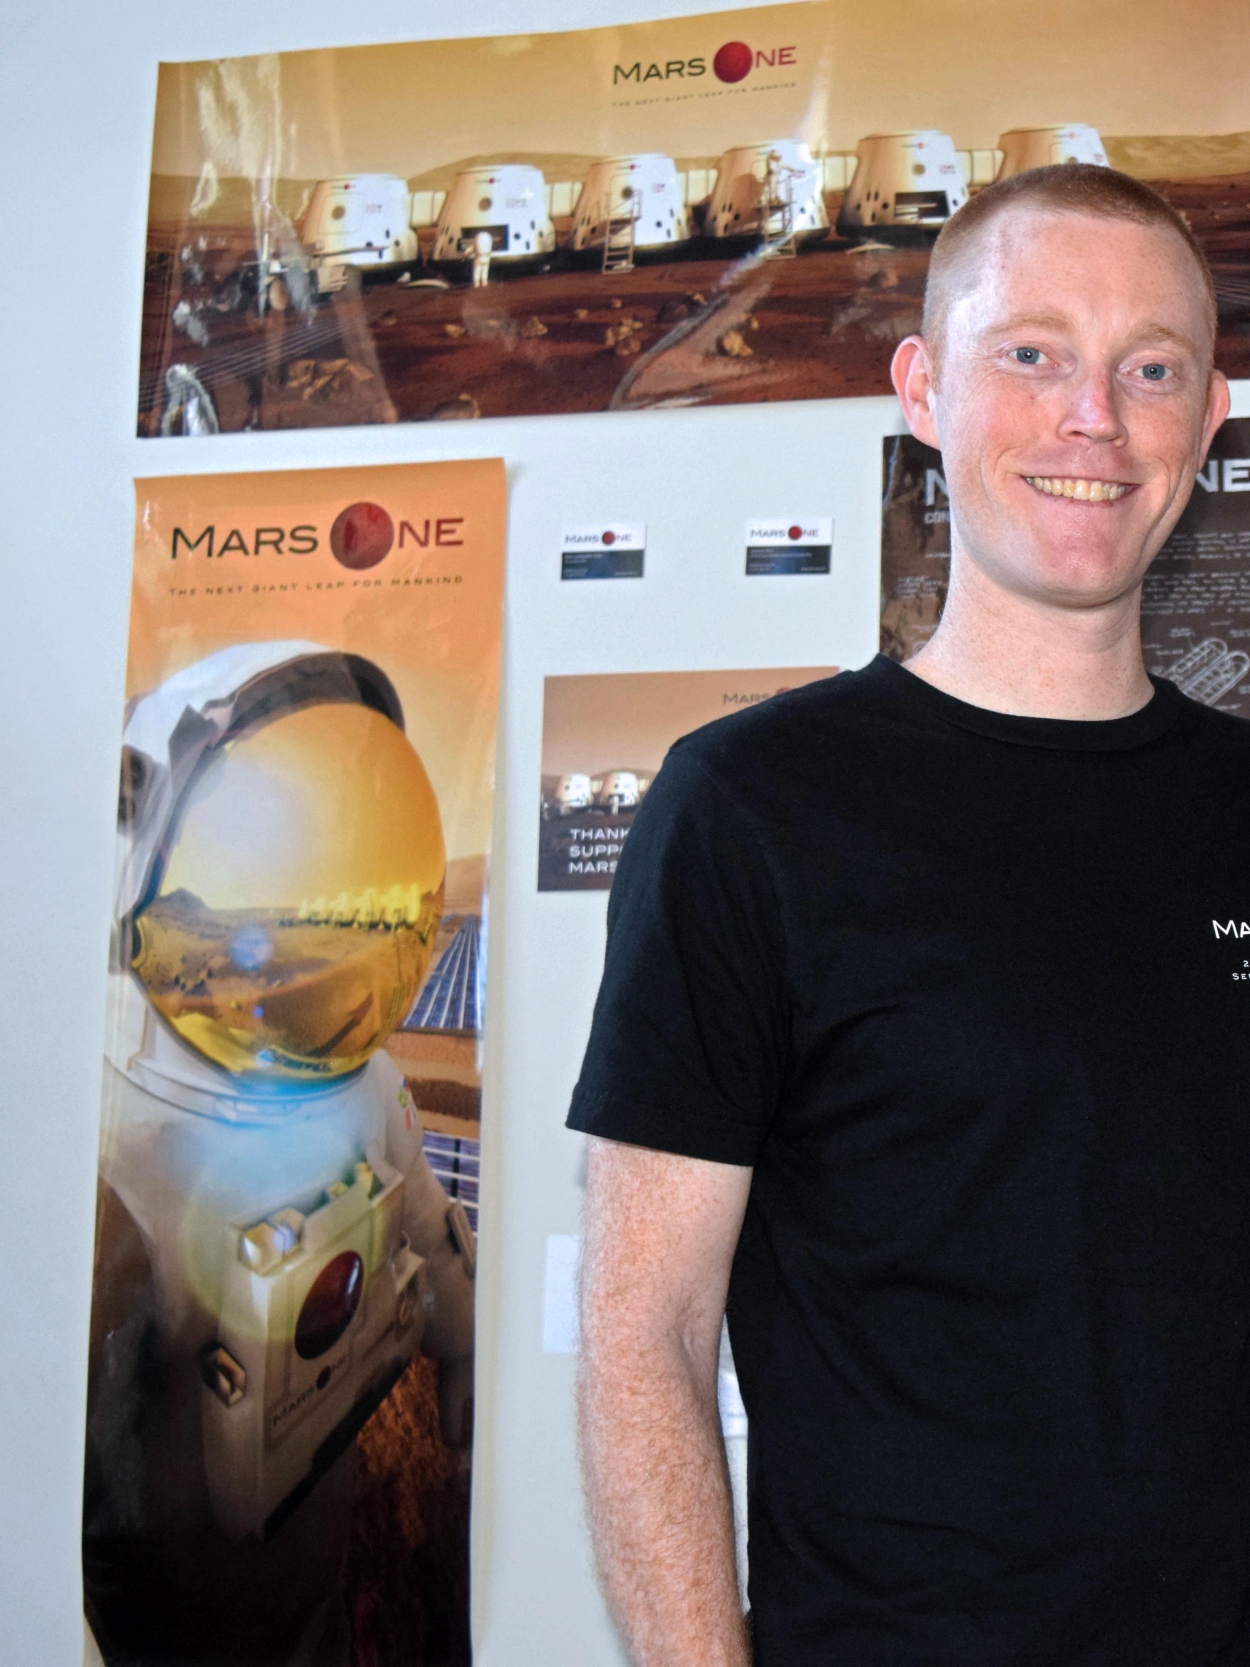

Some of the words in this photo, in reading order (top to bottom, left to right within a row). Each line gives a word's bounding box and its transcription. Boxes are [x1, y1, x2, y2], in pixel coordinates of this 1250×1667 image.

[613, 58, 707, 85] MARS
[171, 525, 319, 560] MARS
[169, 586, 198, 597] THE
[206, 585, 244, 596] NEXT
[252, 582, 298, 594] GIANT
[306, 580, 346, 591] LEAP
[353, 578, 383, 588] FOR
[391, 575, 464, 587] MANKIND
[569, 843, 624, 859] SUPP
[568, 860, 618, 875] MARS
